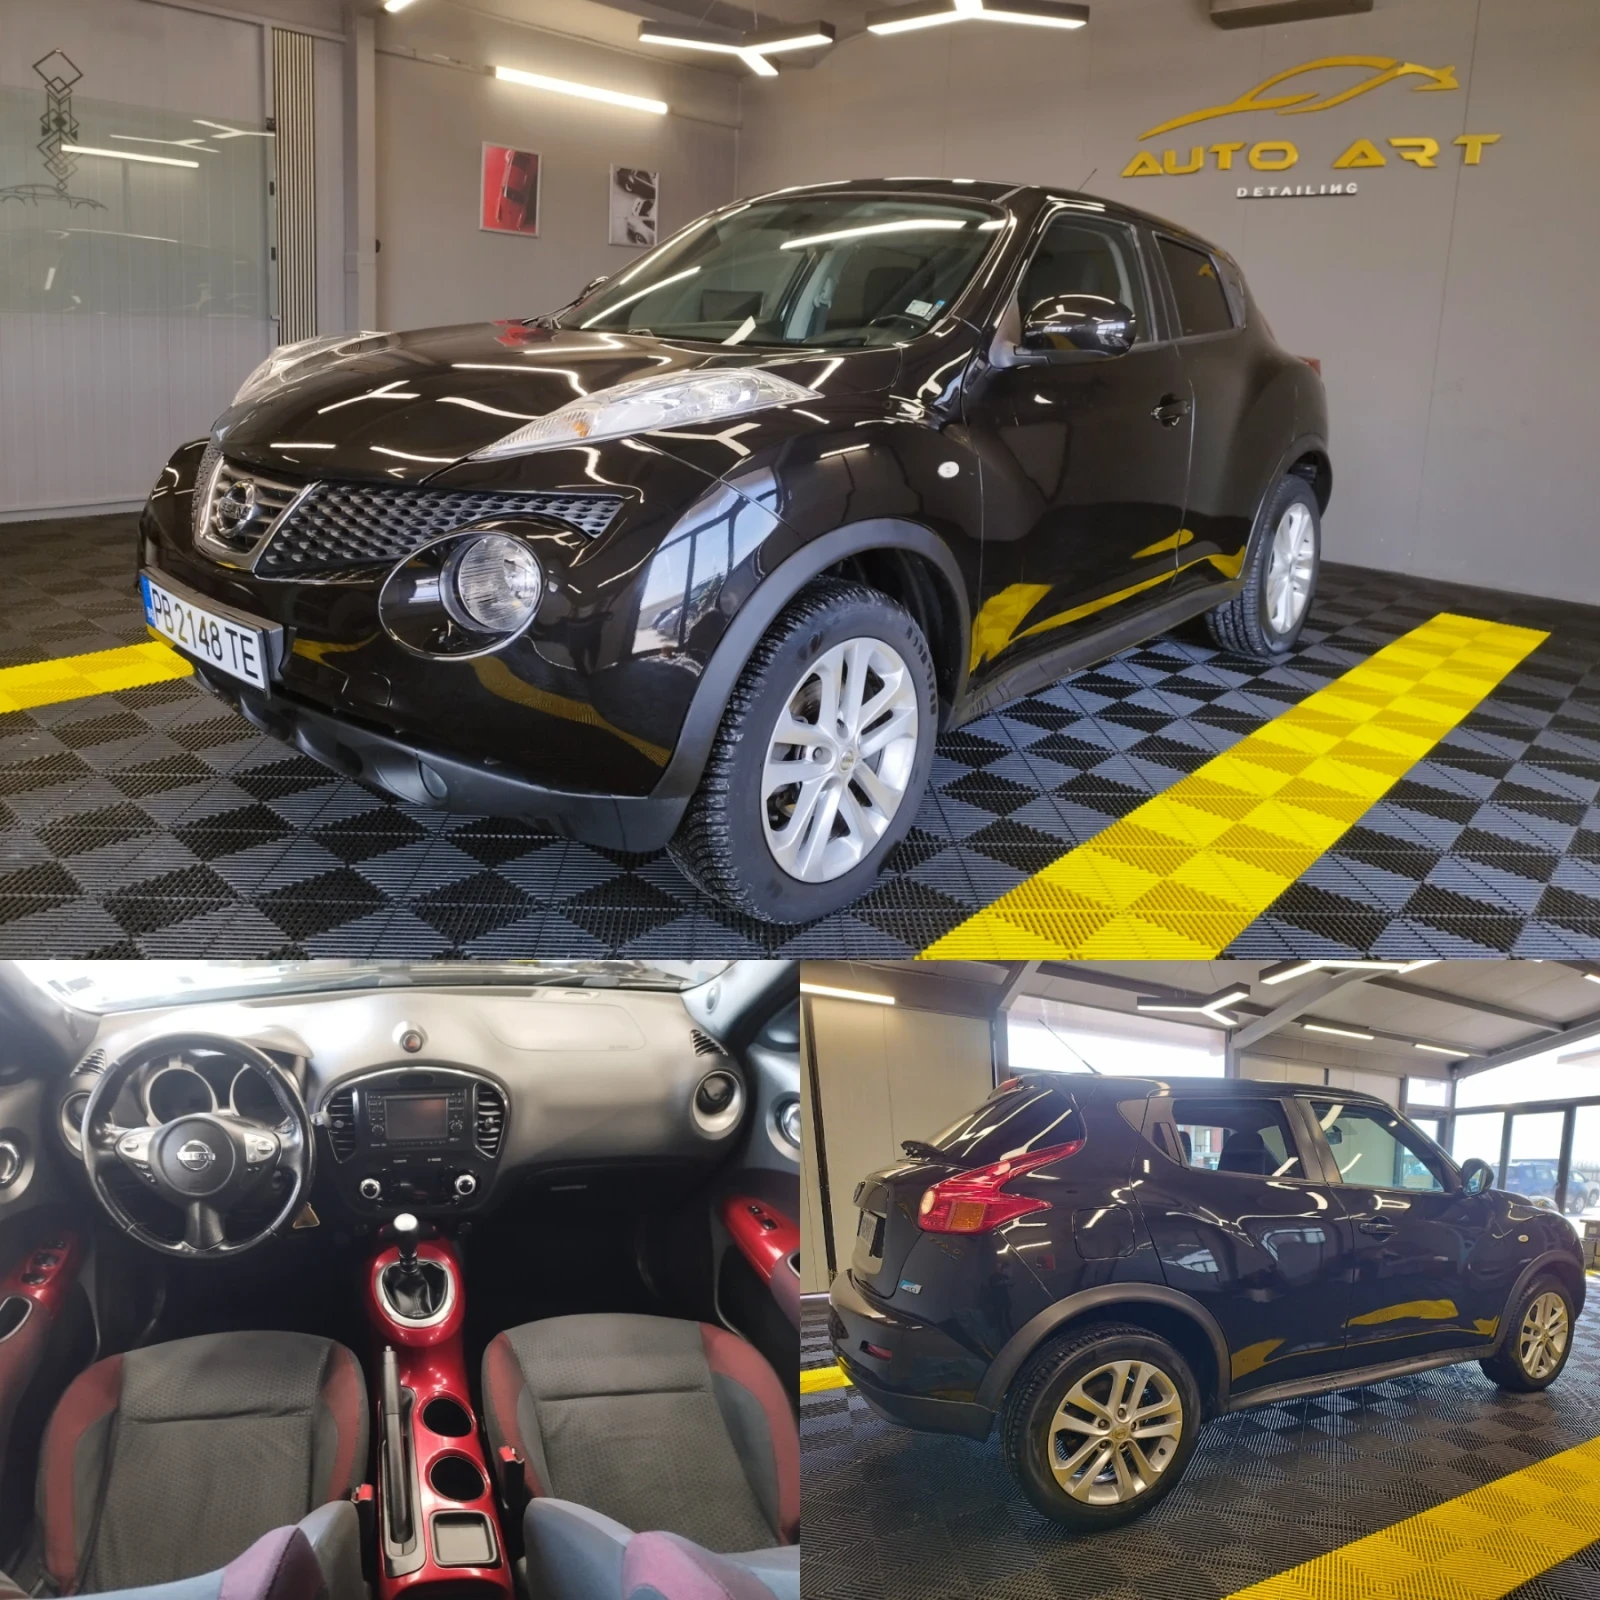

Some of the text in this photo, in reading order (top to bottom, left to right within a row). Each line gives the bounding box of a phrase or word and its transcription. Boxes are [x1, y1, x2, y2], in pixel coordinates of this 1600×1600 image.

[1121, 134, 1502, 178] AUTO ART
[1236, 183, 1358, 198] DETAILING
